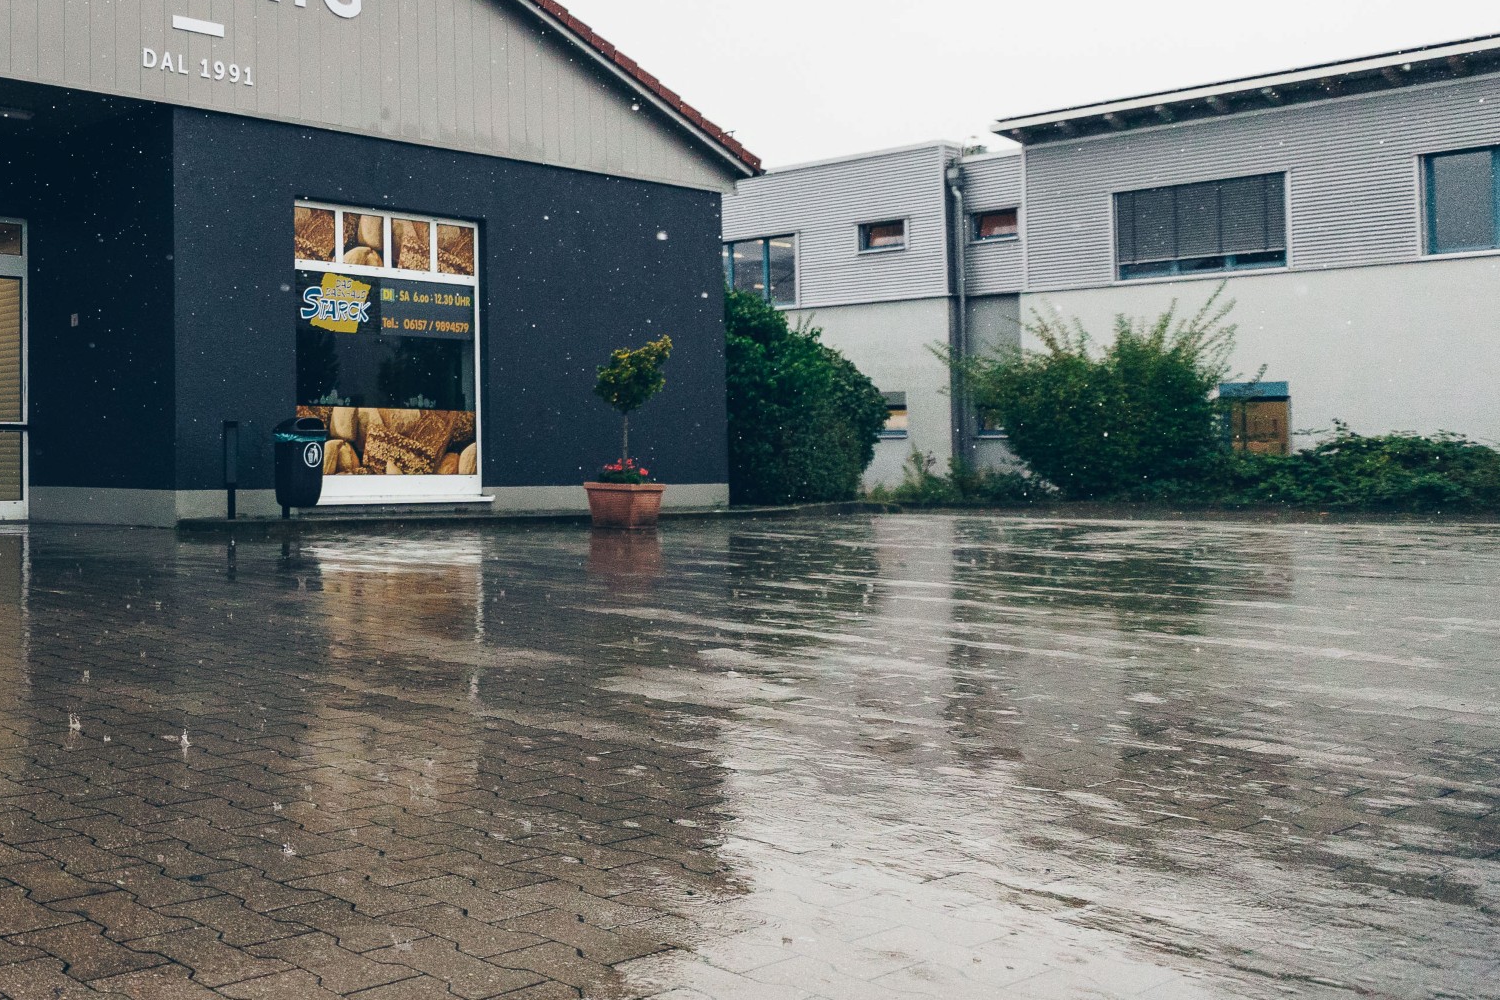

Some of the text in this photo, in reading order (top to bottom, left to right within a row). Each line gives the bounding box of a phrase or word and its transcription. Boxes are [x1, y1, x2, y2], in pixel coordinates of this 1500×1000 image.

[142, 47, 255, 87] DAL 1991
[398, 289, 410, 302] SA
[434, 292, 454, 306] 12.30
[454, 295, 471, 307] UHR
[403, 318, 428, 331] 06157
[435, 320, 470, 334] 9894579
